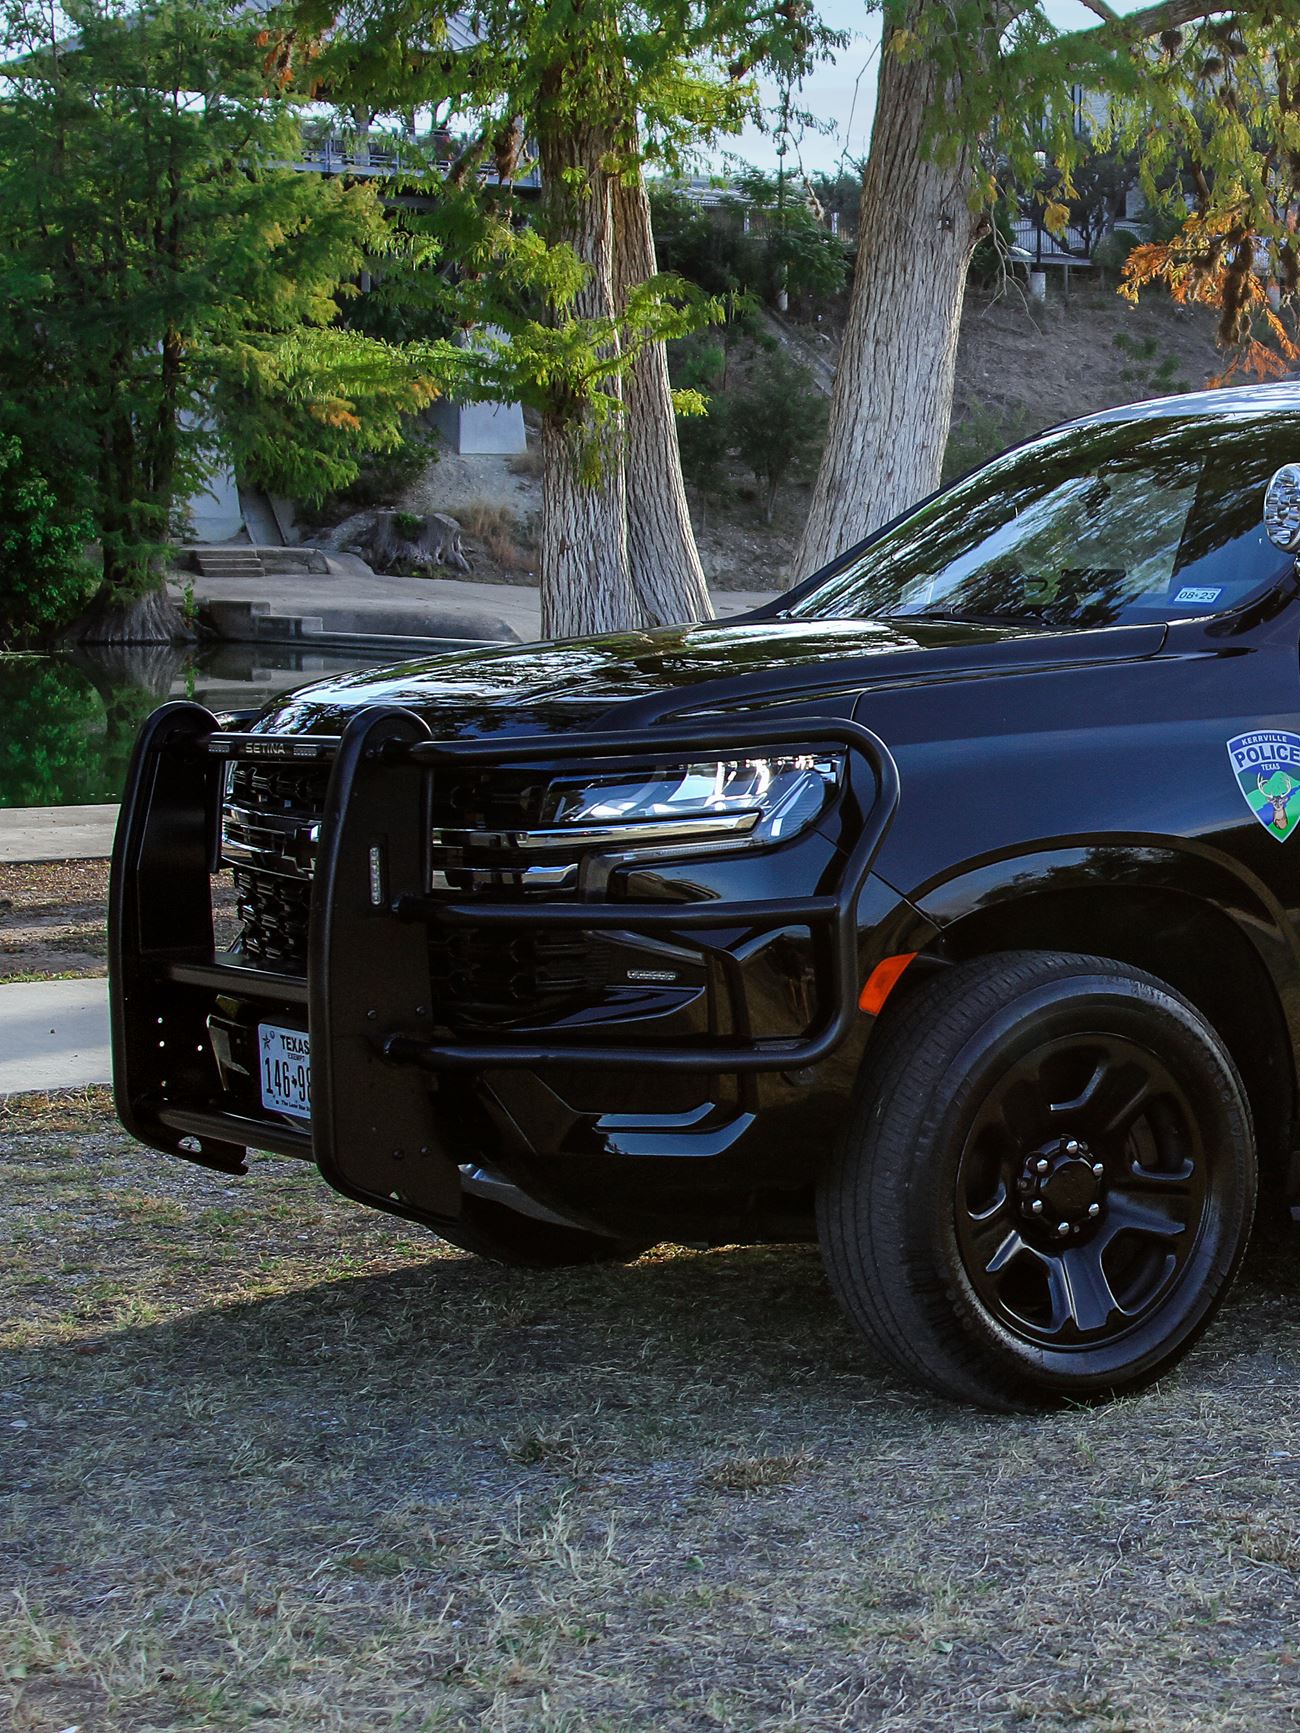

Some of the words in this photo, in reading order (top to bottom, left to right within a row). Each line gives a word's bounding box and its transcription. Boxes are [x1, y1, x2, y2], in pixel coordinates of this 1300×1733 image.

[1242, 735, 1287, 746] KERRVILLE
[245, 743, 285, 754] SETINA
[1234, 744, 1300, 769] POLICE
[1261, 763, 1280, 771] TEXAS
[280, 1035, 310, 1055] TEXAS
